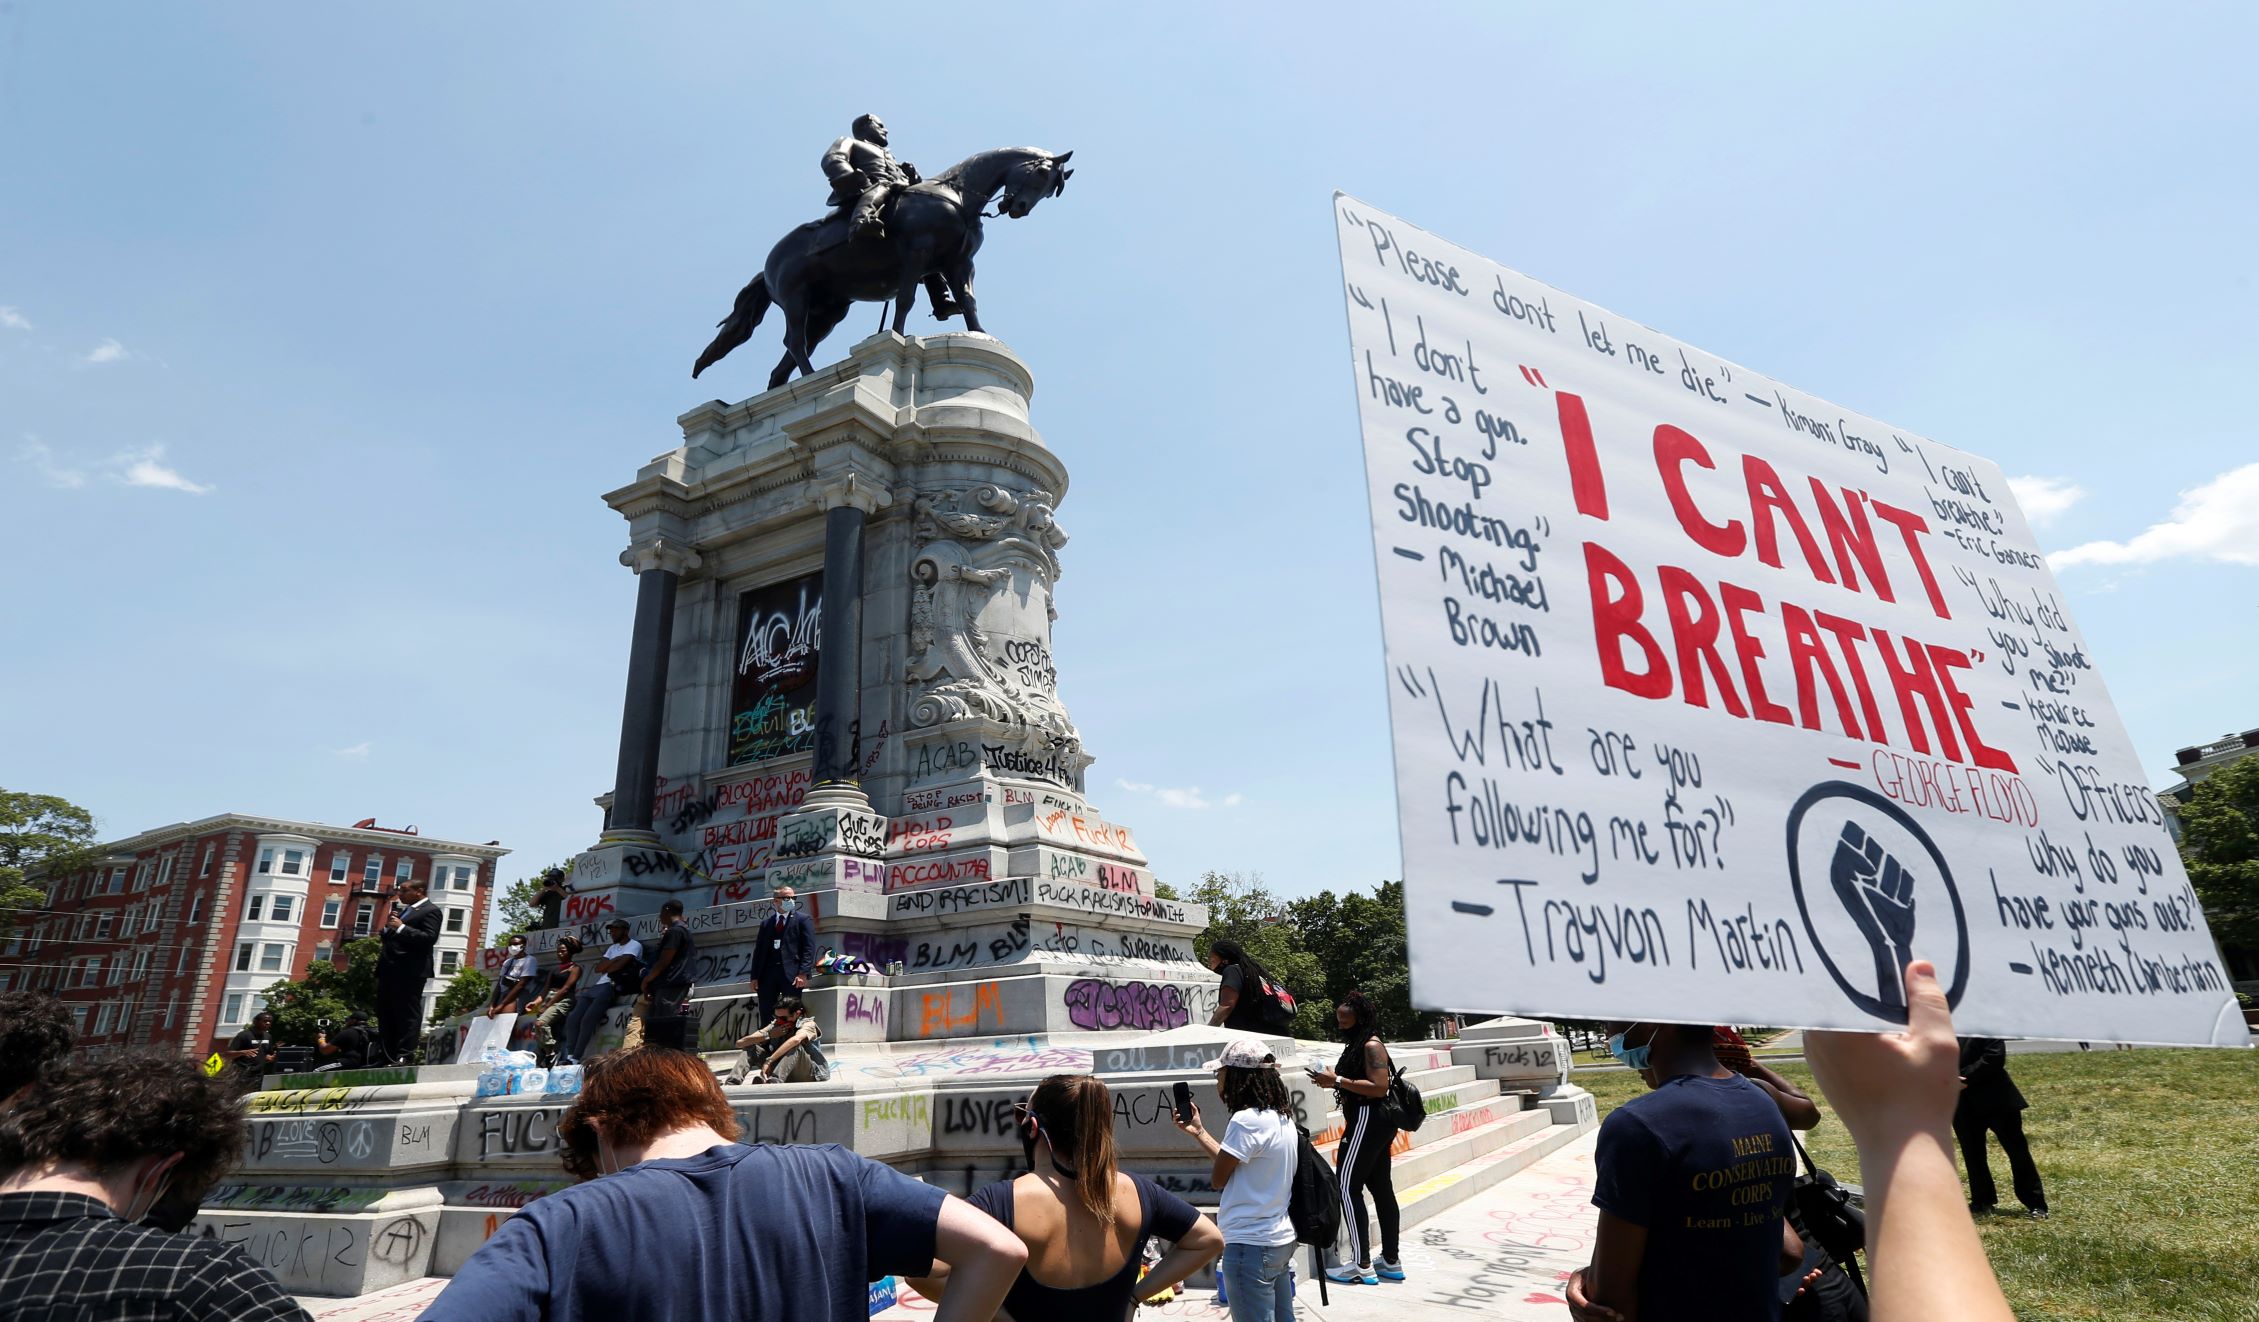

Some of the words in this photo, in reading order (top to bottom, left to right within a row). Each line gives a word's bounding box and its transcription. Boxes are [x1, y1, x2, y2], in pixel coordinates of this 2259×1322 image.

[1366, 349, 1433, 415] have
[1441, 396, 1462, 424] a
[1579, 310, 1615, 356] let
[1626, 341, 1665, 374] me
[1775, 389, 1836, 445] Kimani
[1838, 417, 1889, 475] Gray
[1406, 427, 1492, 499] Stop
[1653, 423, 1952, 621] CAN'T
[1990, 540, 2041, 570] Garner
[1440, 545, 1550, 613] Michael
[1443, 597, 1542, 657] Brown
[2031, 586, 2068, 633] did
[1987, 626, 2029, 676] you
[917, 741, 977, 779] ACAB
[981, 742, 1044, 776] Justice
[1045, 755, 1056, 779] 4
[1587, 728, 1641, 780] are
[1654, 742, 1702, 797] you
[717, 778, 763, 809] BLOOD
[947, 792, 983, 809] RACIST
[1005, 788, 1035, 804] BLM
[1872, 749, 1970, 814] GEORGE
[1966, 767, 2040, 829] FLOYD
[704, 823, 748, 847] BLACK
[748, 814, 785, 842] LIVE
[890, 816, 953, 845] HOLD
[1446, 771, 1599, 885] following
[1609, 814, 1659, 865] me
[621, 851, 681, 877] BLM
[843, 859, 885, 884] BLM
[1097, 863, 1141, 896] BLM
[2084, 830, 2118, 885] do
[2121, 844, 2163, 895] you
[895, 890, 934, 912] END
[1081, 888, 1128, 917] RACISM
[1989, 867, 2054, 929] have
[2060, 899, 2099, 950] your
[2105, 900, 2149, 950] guns
[1497, 879, 1670, 985] Trayvon
[1687, 897, 1804, 975] Martin
[912, 942, 978, 968] BLM
[2030, 940, 2132, 997] Kenneth
[845, 992, 884, 1030] BLM
[919, 981, 1005, 1038] BLM
[1106, 1047, 1156, 1071] all
[1533, 1049, 1556, 1067] 12
[741, 1108, 817, 1145] LM
[1112, 1088, 1195, 1129] ACA
[277, 1119, 316, 1141] LOVE
[400, 1124, 431, 1150] BLM
[478, 1109, 562, 1162] FUC
[1731, 1133, 1774, 1158] MAINE
[1731, 1181, 1773, 1207] CORPS
[1685, 1215, 1732, 1229] Learn
